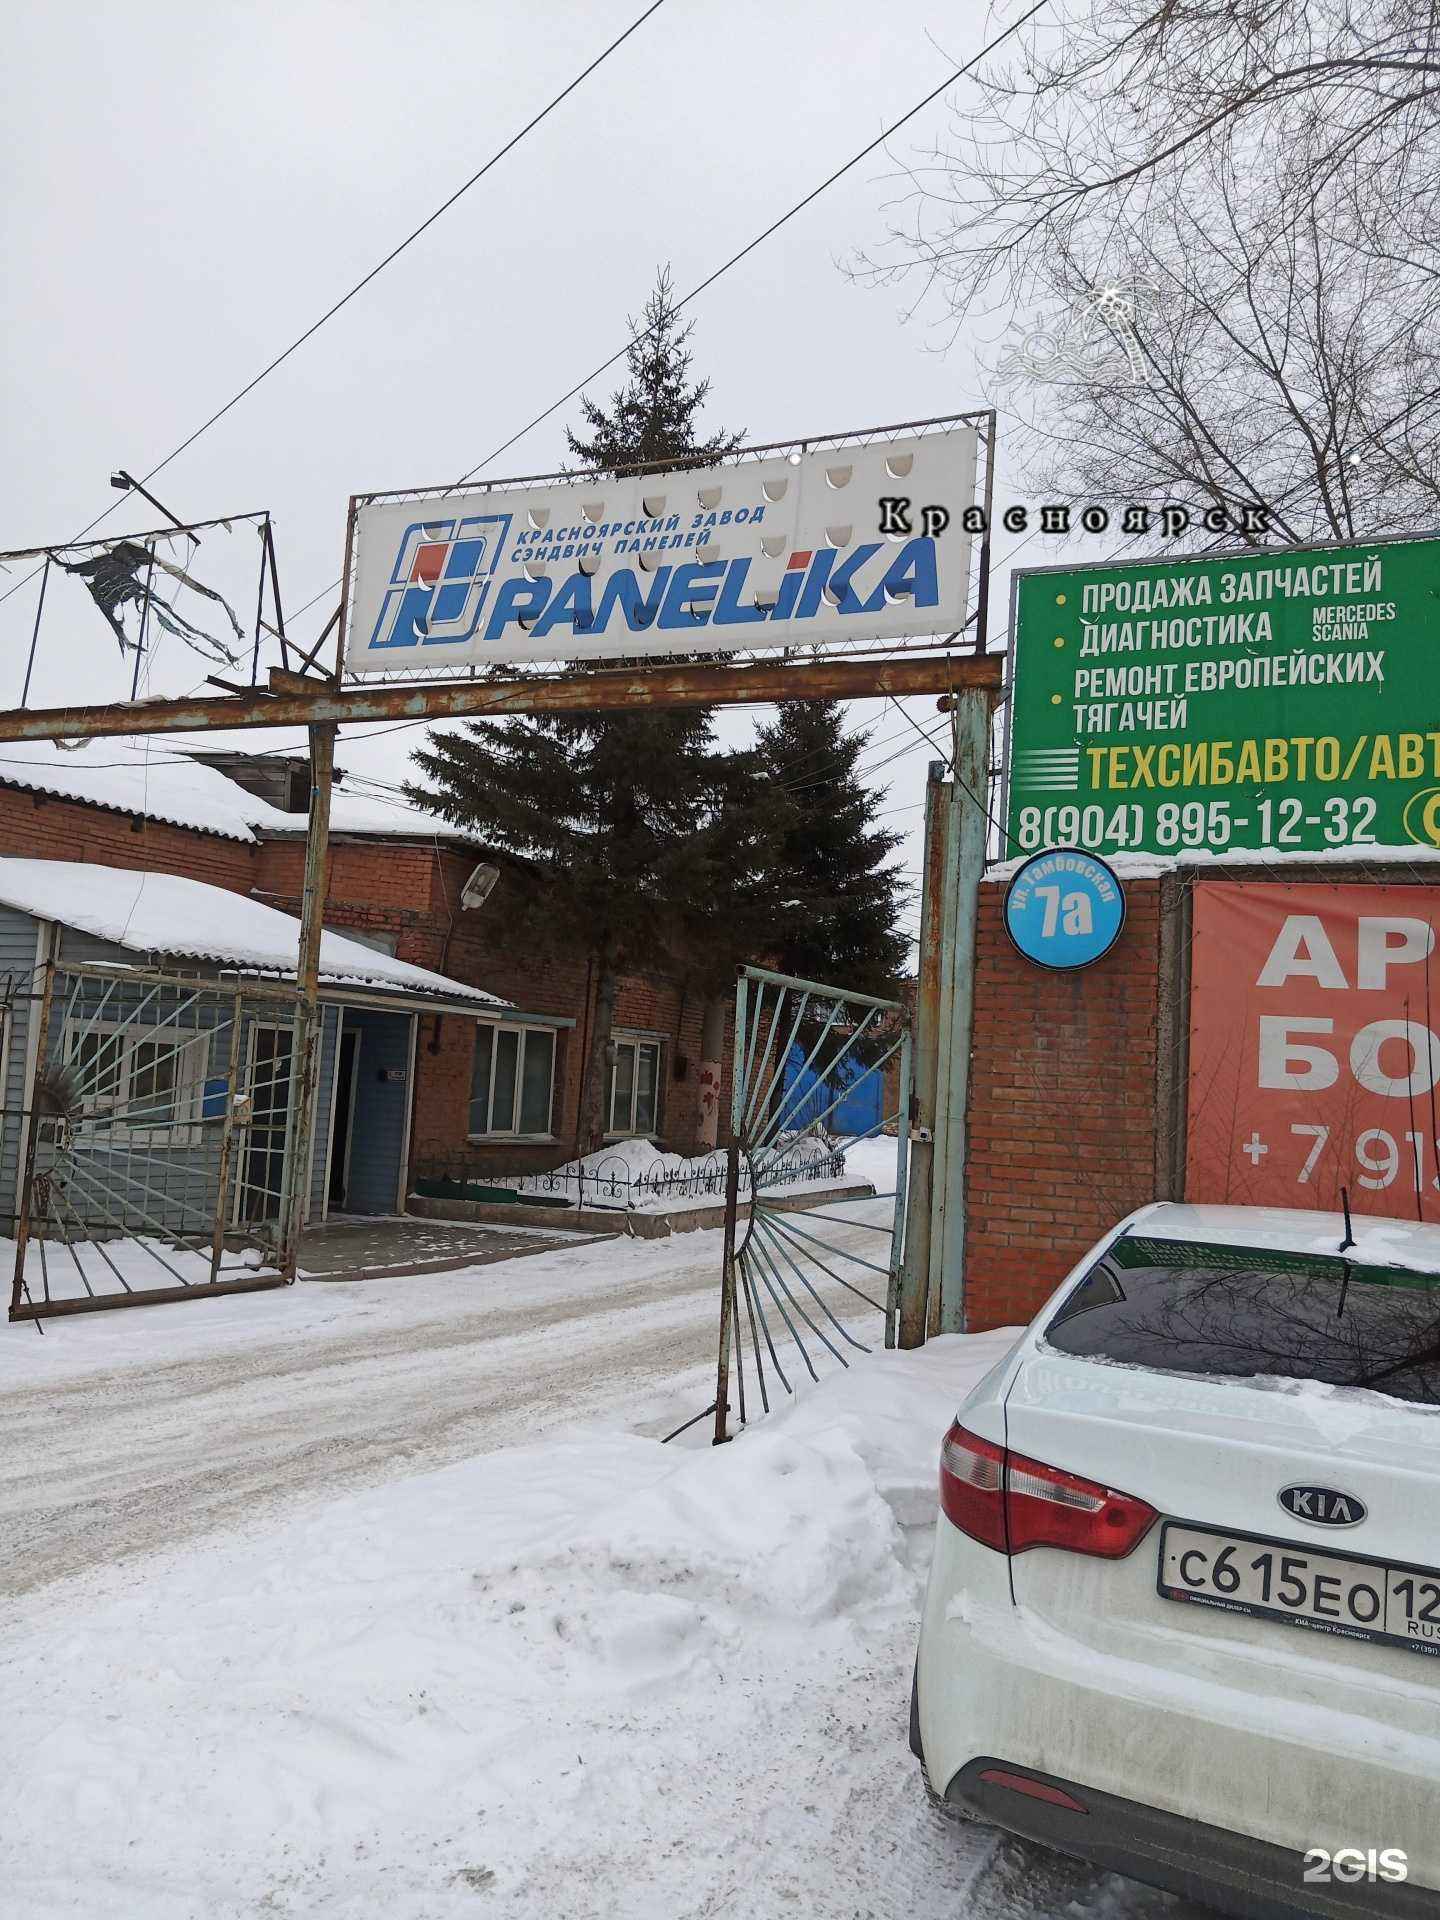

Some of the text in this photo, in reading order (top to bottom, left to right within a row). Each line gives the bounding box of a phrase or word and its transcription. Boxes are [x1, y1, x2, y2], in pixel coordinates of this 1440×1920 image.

[516, 505, 765, 545] КРАСНОЯРСКИЙ ЗАВОД
[510, 530, 712, 563] СЭНДВИЧ ПАНЕЛЕЙ
[1081, 555, 1382, 614] ПРОДАЖА ЗАПЧАСТЕЙ
[1079, 612, 1273, 657] ДИАГНОСТИКА
[1312, 602, 1397, 625] MERCEDES
[1312, 622, 1369, 643] SCANIA
[1074, 649, 1385, 698] РЕМОНТ ЕВРОПЕЙСКИХ
[1073, 694, 1188, 733] ТЯГАЧЕЙ
[1018, 796, 1377, 849] 8(904) 895-12-32
[1256, 915, 1435, 990] АР
[1258, 1015, 1440, 1097] БО
[1292, 1490, 1352, 1521] KIA
